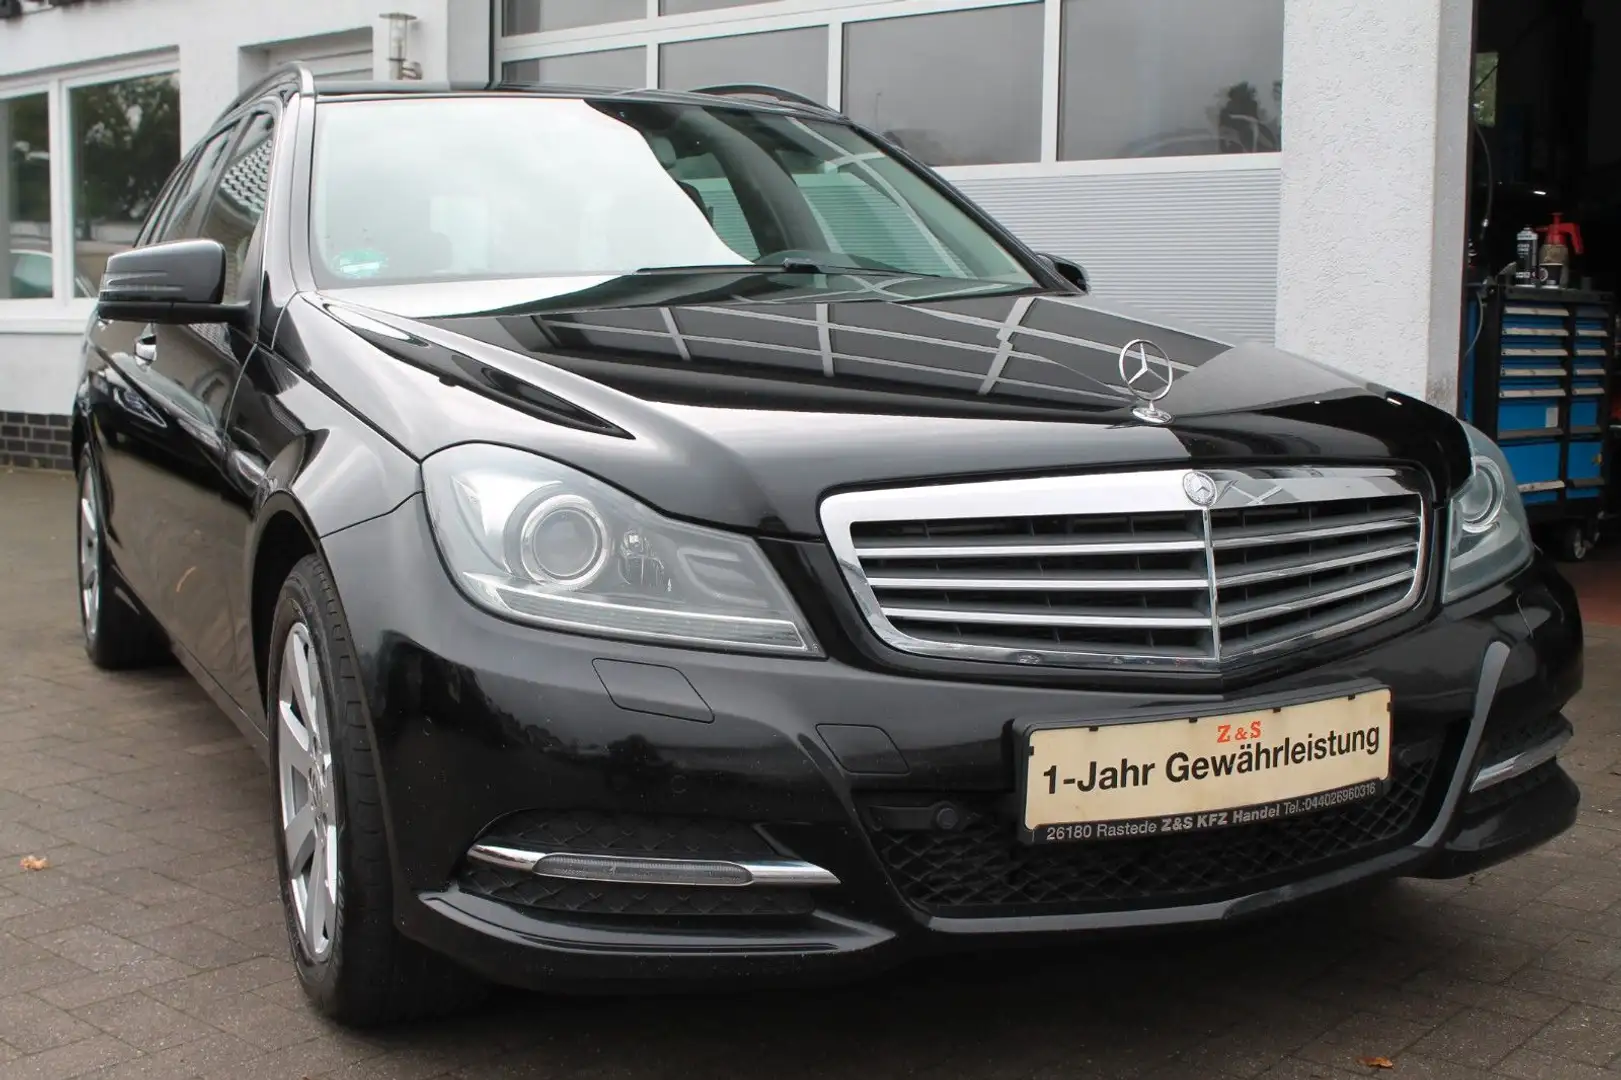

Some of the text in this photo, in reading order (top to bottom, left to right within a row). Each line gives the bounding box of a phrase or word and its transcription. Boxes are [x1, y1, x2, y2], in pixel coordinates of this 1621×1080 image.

[1043, 726, 1380, 794] 1-Jahr Gewährleistung
[1046, 824, 1092, 841] 26180
[1096, 820, 1157, 838] Rastede
[1161, 817, 1193, 832] Z&S
[1196, 812, 1228, 828] KFZ
[1232, 805, 1280, 824] Handel
